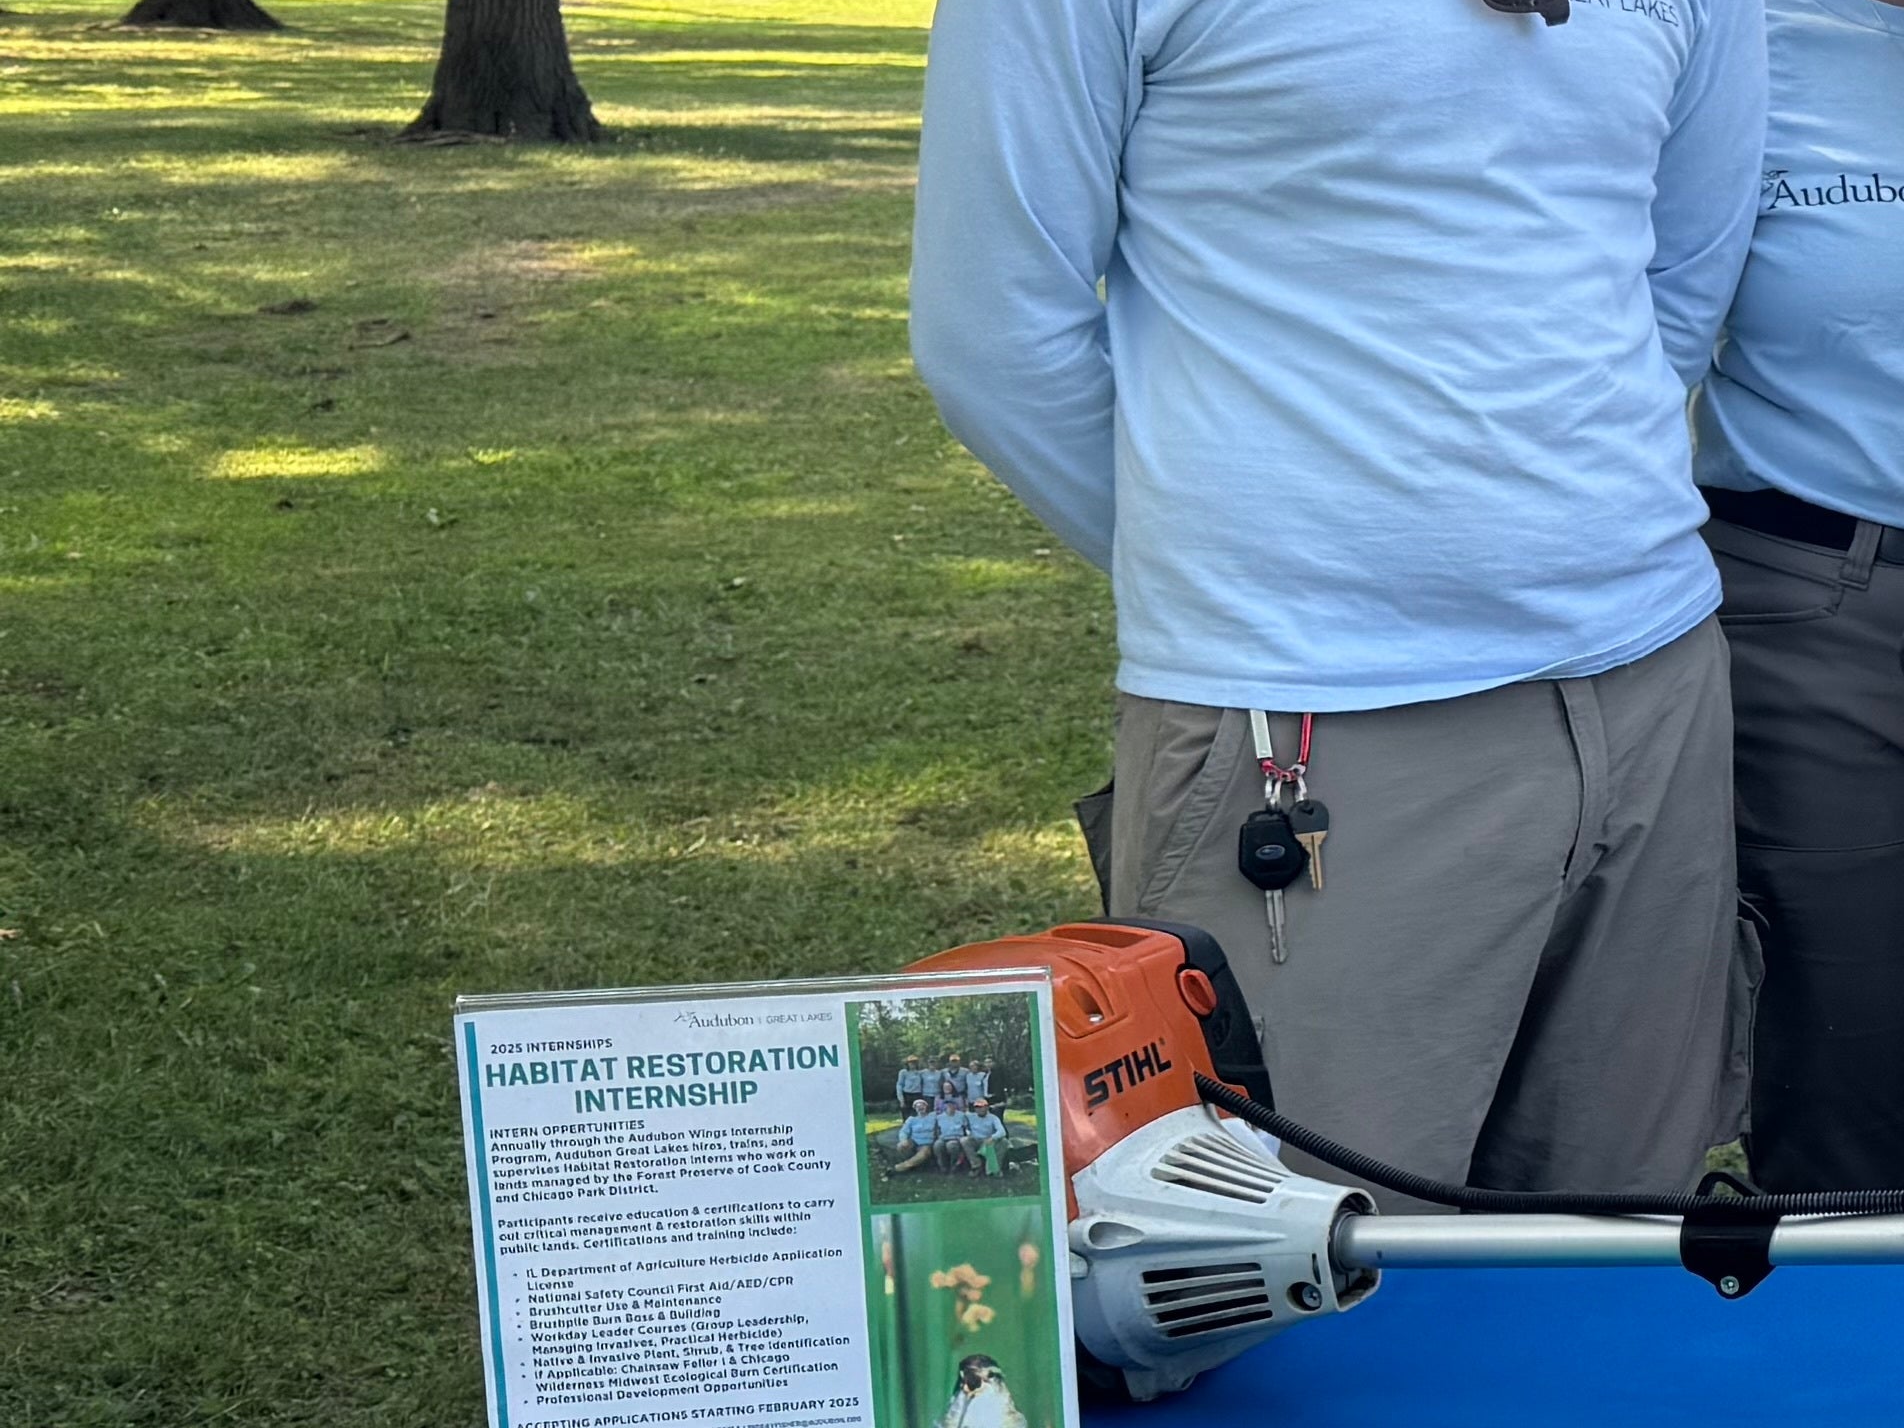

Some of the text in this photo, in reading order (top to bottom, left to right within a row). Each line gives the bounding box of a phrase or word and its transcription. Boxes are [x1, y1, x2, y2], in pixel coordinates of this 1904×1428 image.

[685, 1011, 833, 1028] Audubon GREAT LAKES
[490, 1038, 612, 1054] 2025 INTERNSHIPS
[485, 1044, 839, 1087] HABITAT RESTORATION
[1084, 1042, 1172, 1109] STIHL
[574, 1080, 759, 1113] INTERNSHIP
[593, 1410, 687, 1427] APPLICATIONS
[691, 1404, 754, 1418] STARTING
[758, 1398, 824, 1413] FEBRUARY
[829, 1396, 859, 1408] 2025
